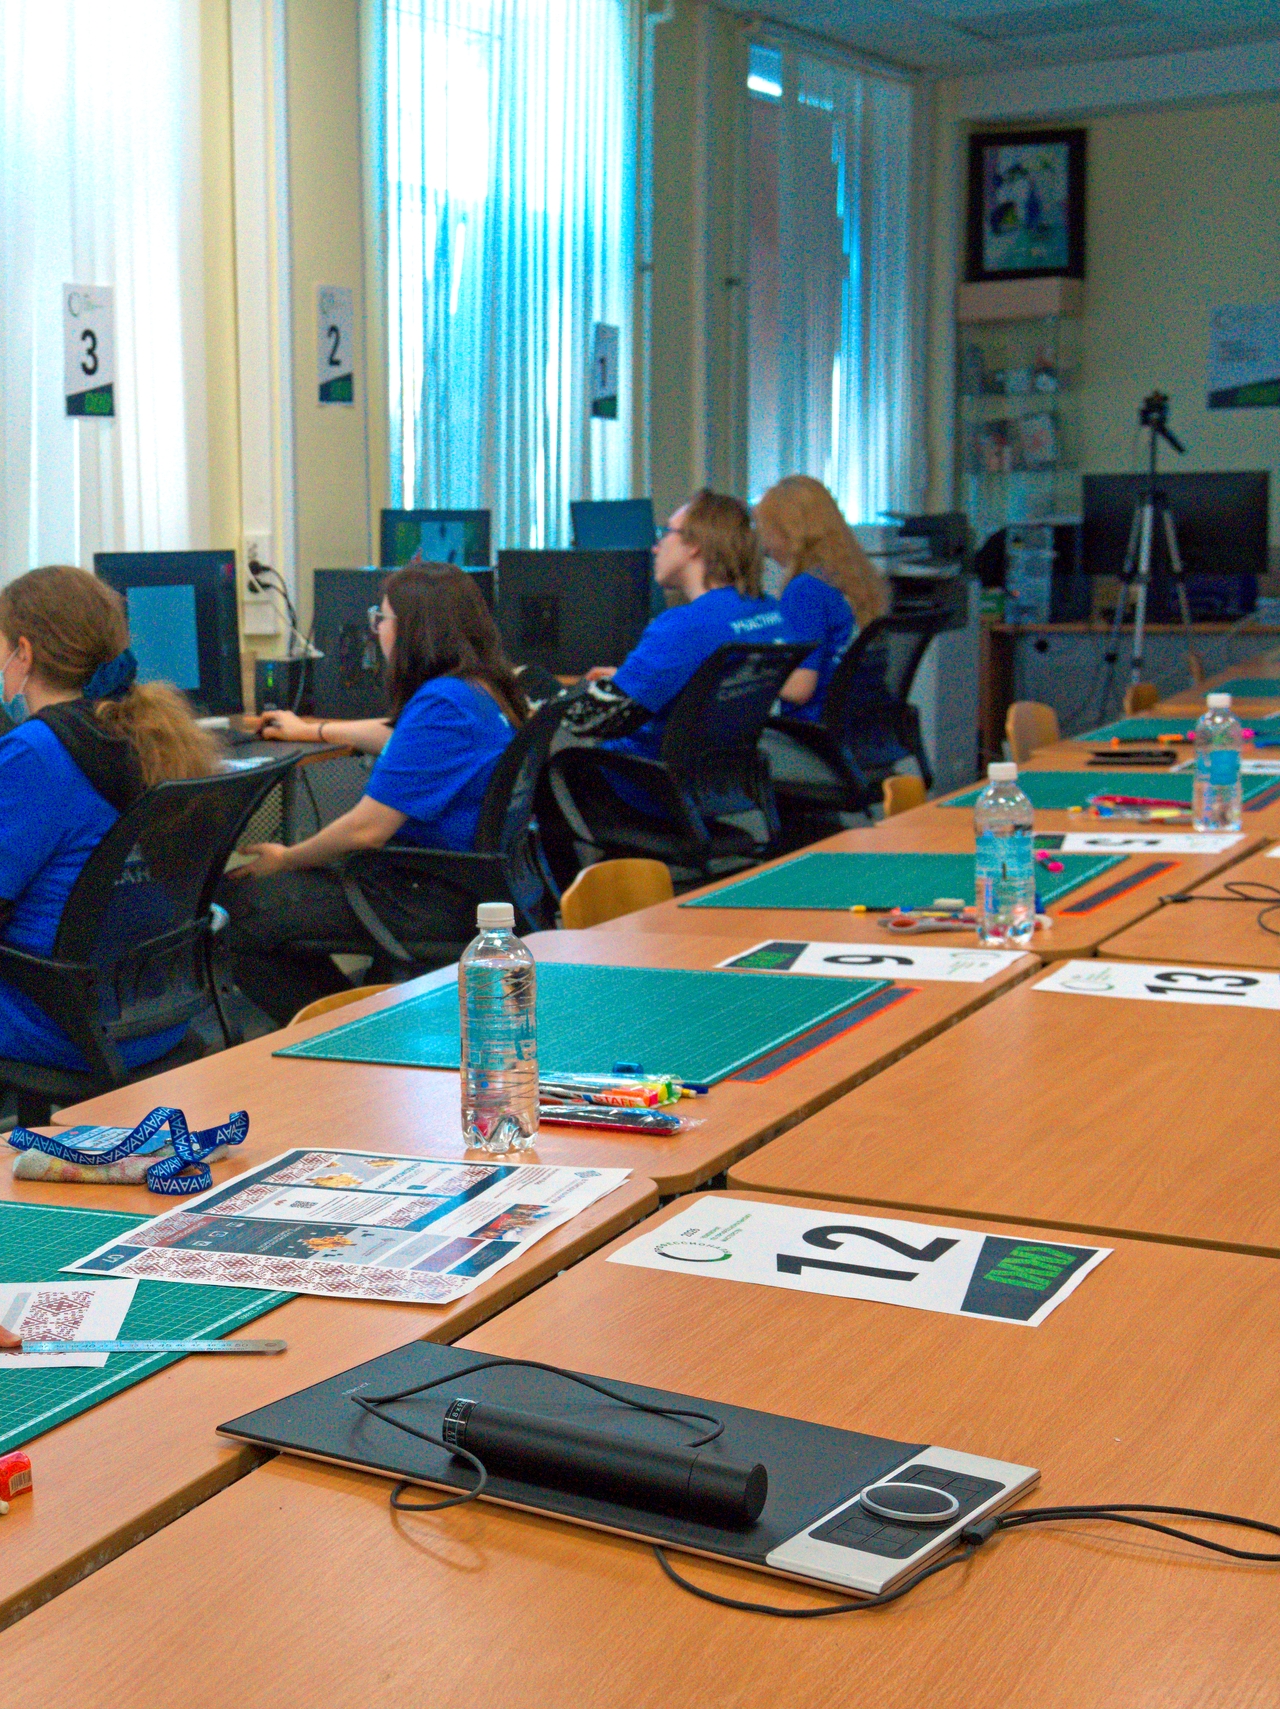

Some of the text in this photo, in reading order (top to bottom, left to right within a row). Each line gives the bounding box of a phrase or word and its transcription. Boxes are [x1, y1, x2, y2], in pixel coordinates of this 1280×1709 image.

[80, 328, 99, 376] 3
[326, 325, 341, 366] 2
[1144, 971, 1260, 997] 13
[593, 1095, 636, 1108] STAFF
[776, 1225, 961, 1282] 12
